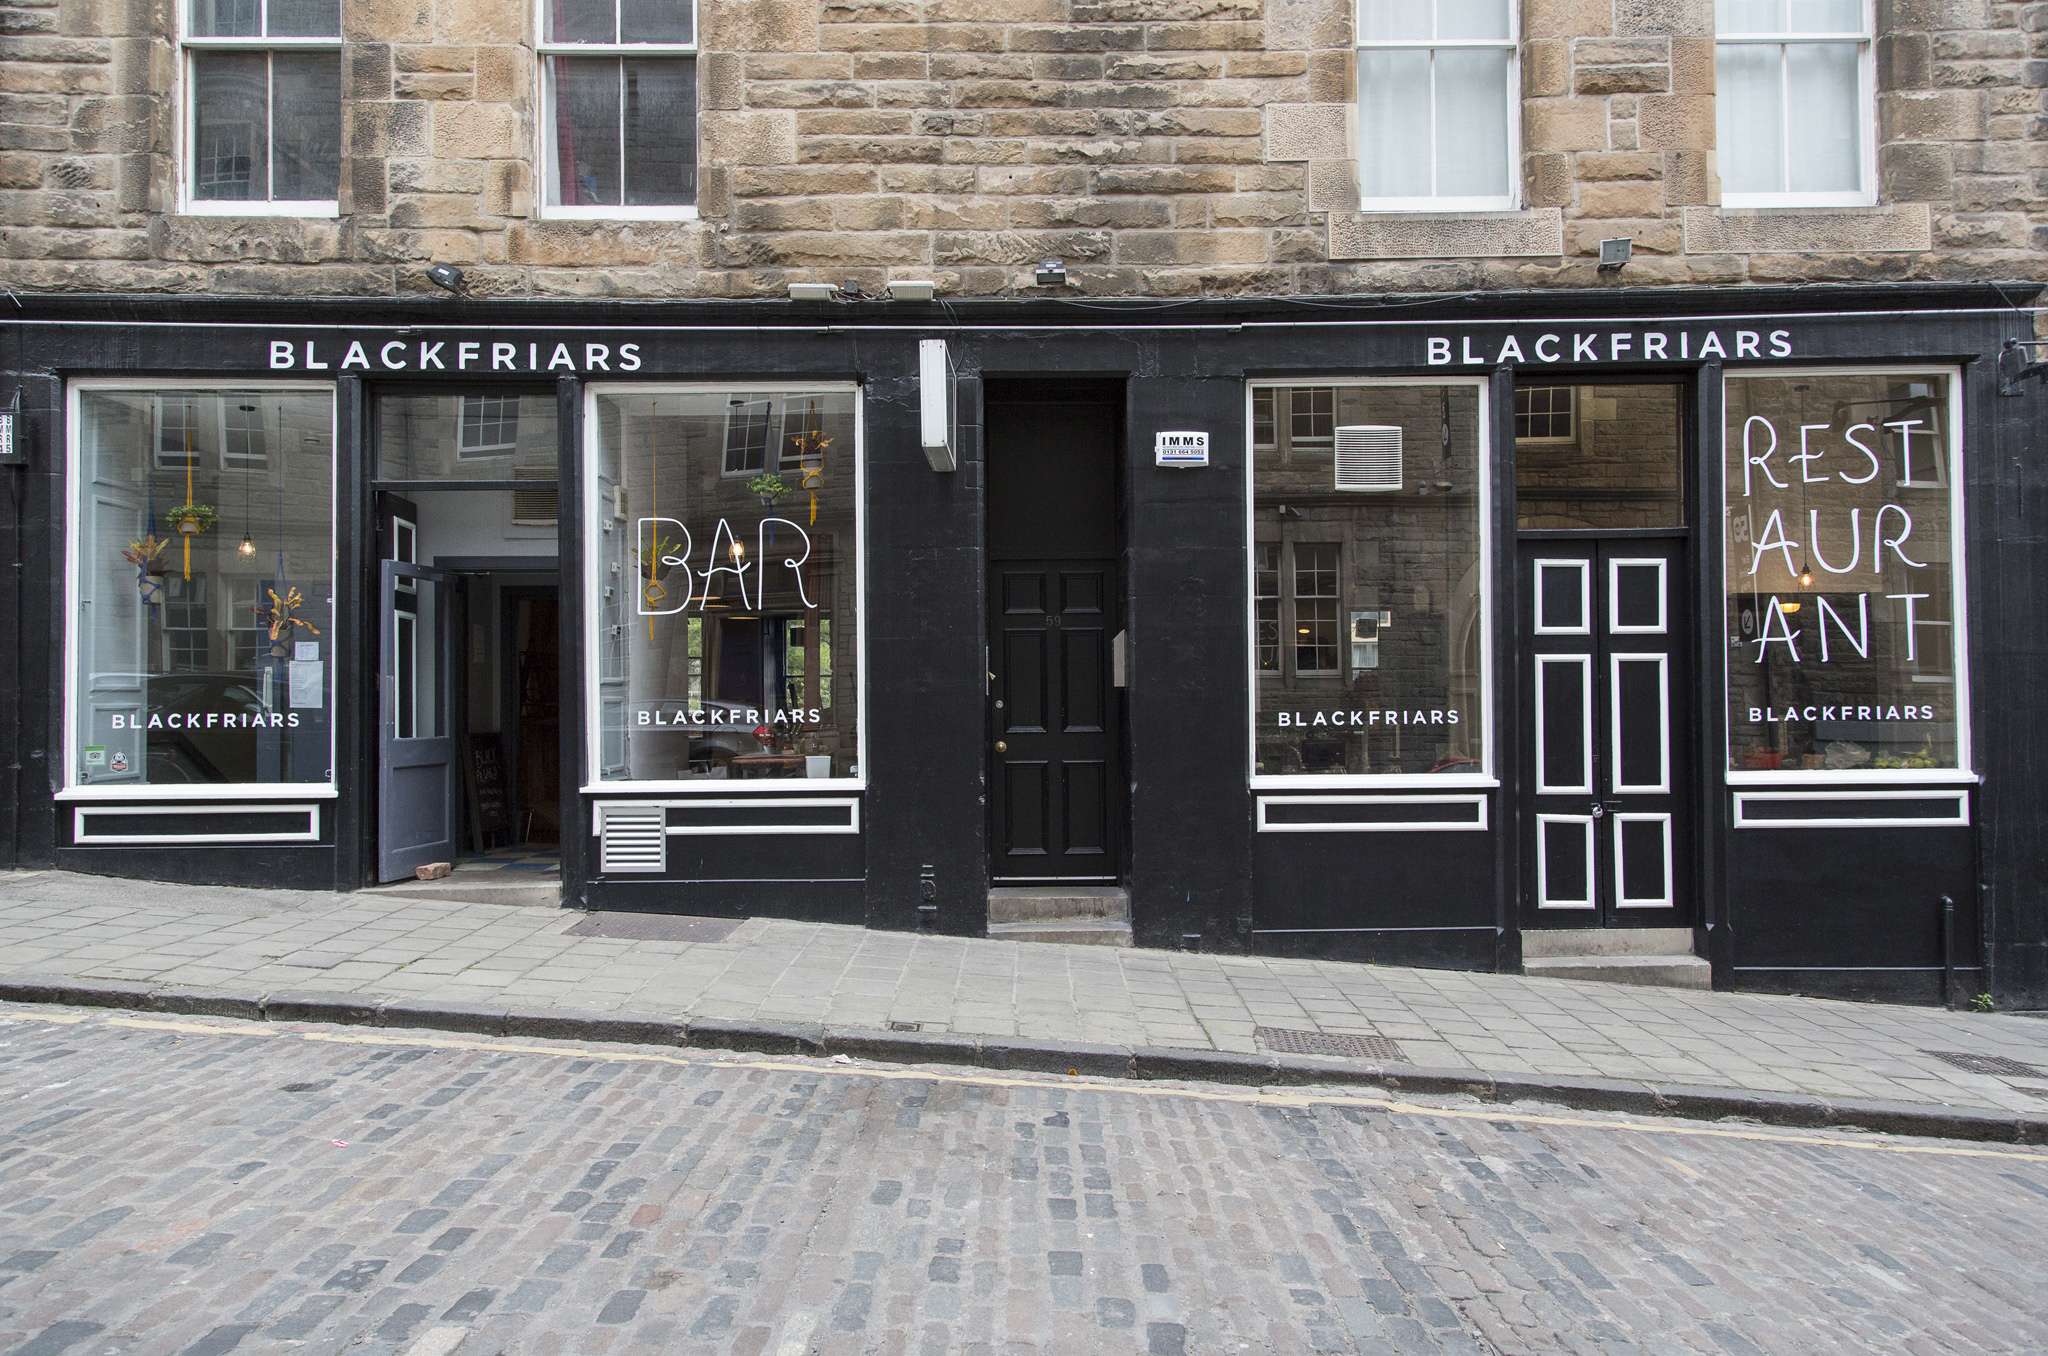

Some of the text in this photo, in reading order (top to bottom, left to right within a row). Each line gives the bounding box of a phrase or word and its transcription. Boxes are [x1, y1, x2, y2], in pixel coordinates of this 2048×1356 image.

[269, 340, 642, 371] BLACKFRIARS
[1426, 330, 1793, 365] BLACKFRIARS
[1162, 436, 1205, 446] IMMS
[1743, 415, 1923, 497] REST
[1748, 504, 1928, 578] AUR
[637, 517, 818, 616] BAR
[1046, 615, 1061, 627] 59
[1751, 593, 1930, 664] ANT
[111, 711, 301, 730] BLACKFRIARS
[637, 707, 821, 726] BLACKFRIARS
[1277, 708, 1460, 727] BLACKFRIARS
[1749, 704, 1934, 722] BLACKFRIARS
